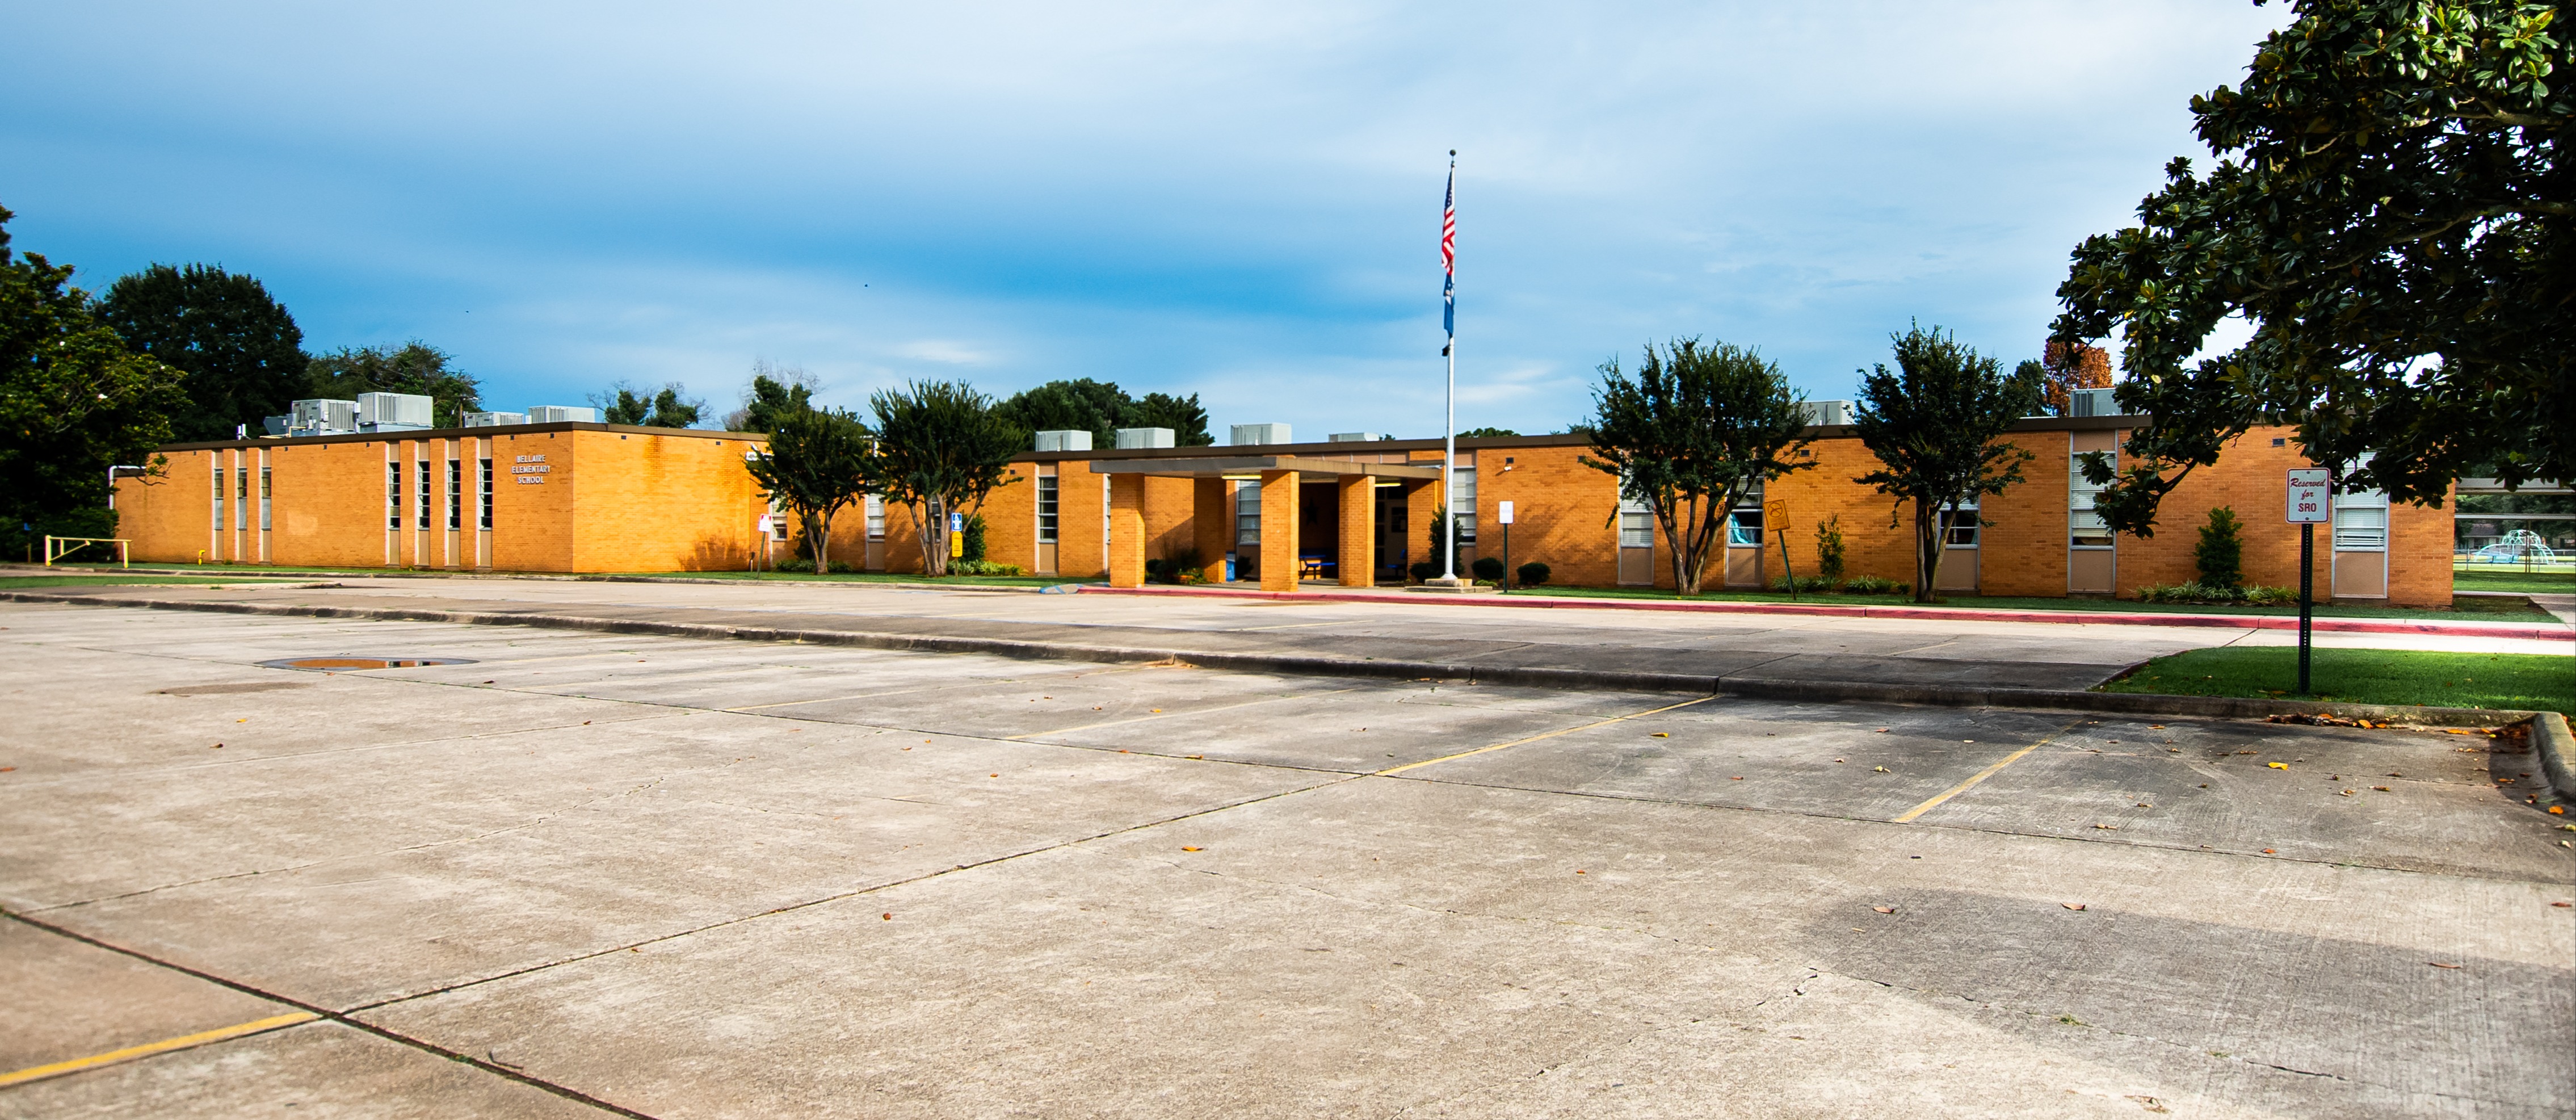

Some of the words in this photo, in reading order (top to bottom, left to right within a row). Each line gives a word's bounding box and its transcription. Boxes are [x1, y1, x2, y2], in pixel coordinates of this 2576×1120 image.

[516, 455, 545, 463] BELLAIRE
[511, 465, 551, 474] ELEMENTARY
[2290, 477, 2326, 488] Reserved
[2301, 489, 2314, 500] for
[2298, 503, 2317, 512] SRO
